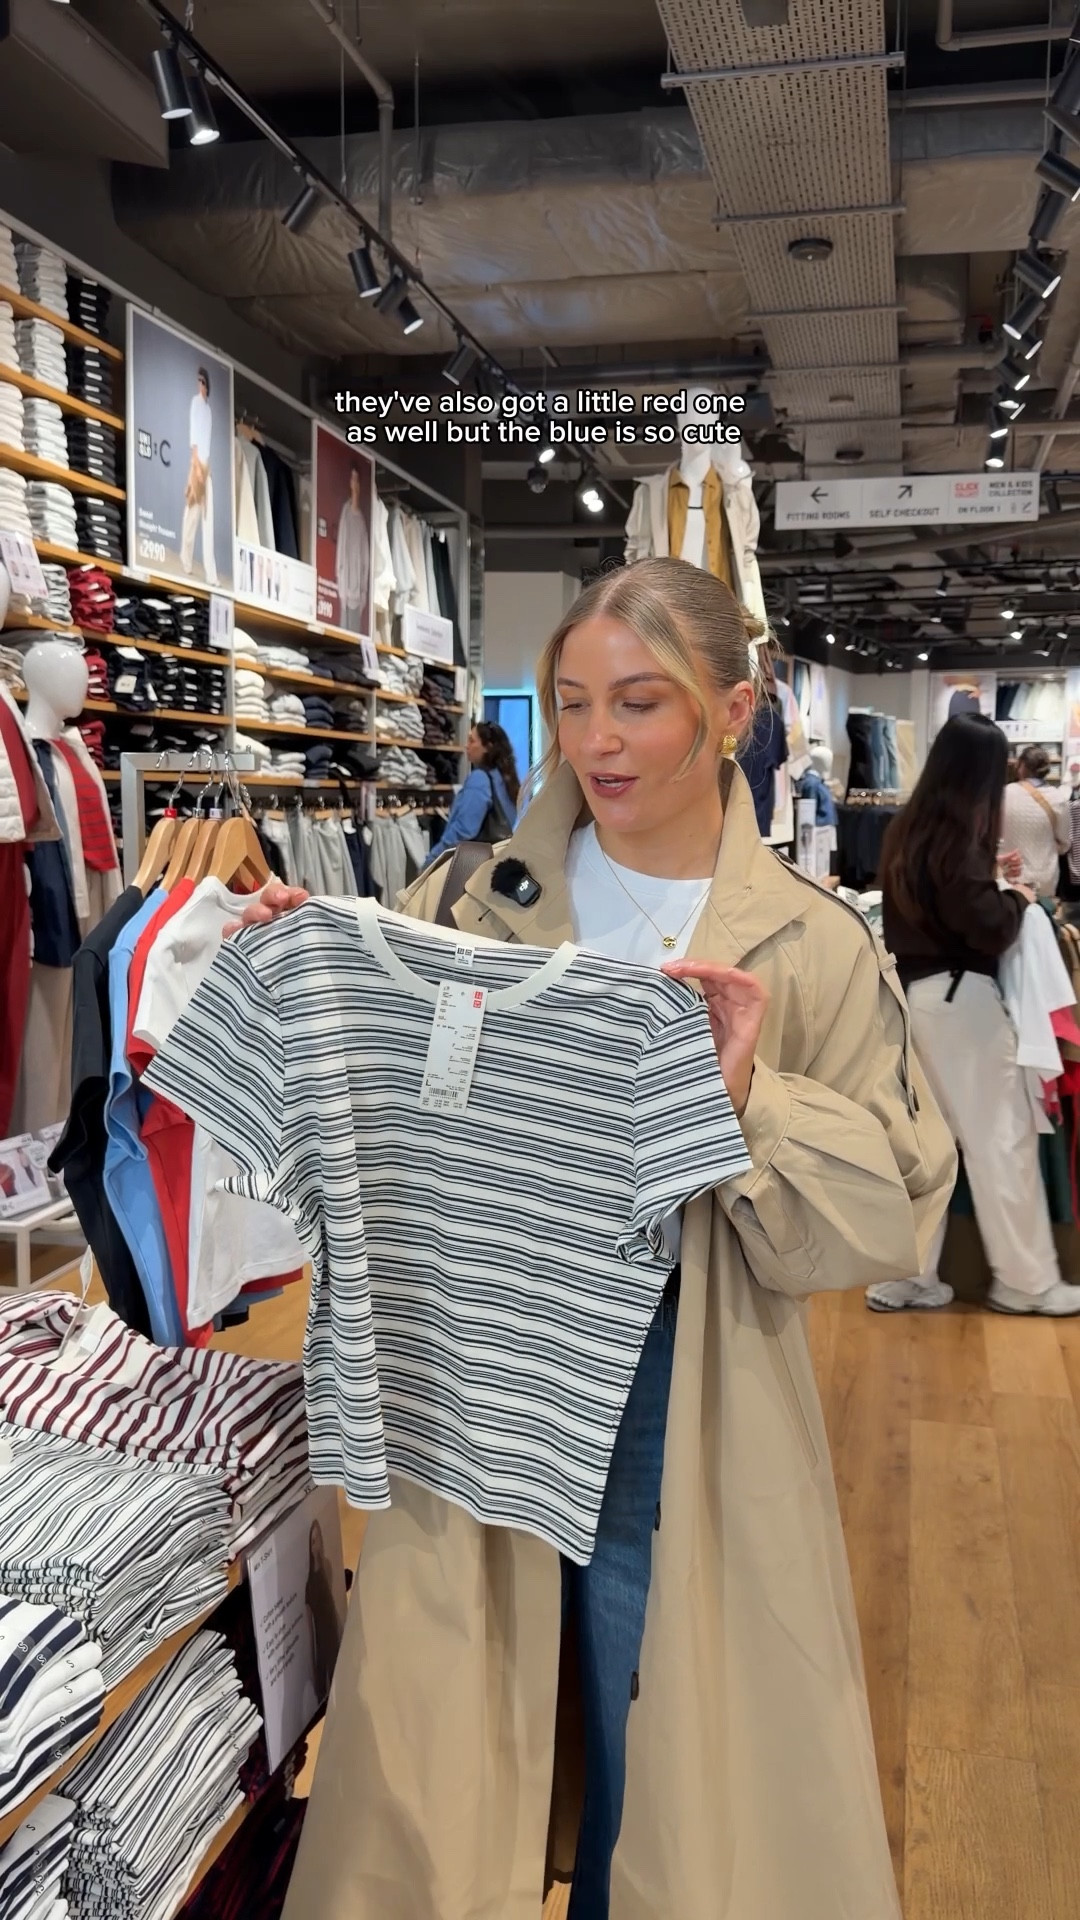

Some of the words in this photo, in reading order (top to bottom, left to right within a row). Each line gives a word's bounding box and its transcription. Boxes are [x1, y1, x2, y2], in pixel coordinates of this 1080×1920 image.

[988, 489, 1033, 497] COLLECTION
[786, 510, 819, 520] FITTING
[821, 509, 850, 520] ROOMS
[869, 508, 892, 518] SELF
[893, 507, 940, 518] CHECKOUT
[970, 506, 996, 514] FLOOR
[425, 1079, 431, 1087] L
[18, 1642, 28, 1652] S
[37, 1654, 46, 1665] S
[66, 1659, 74, 1668] S
[64, 1685, 73, 1694] S
[59, 1716, 67, 1727] S
[54, 1749, 62, 1760] S
